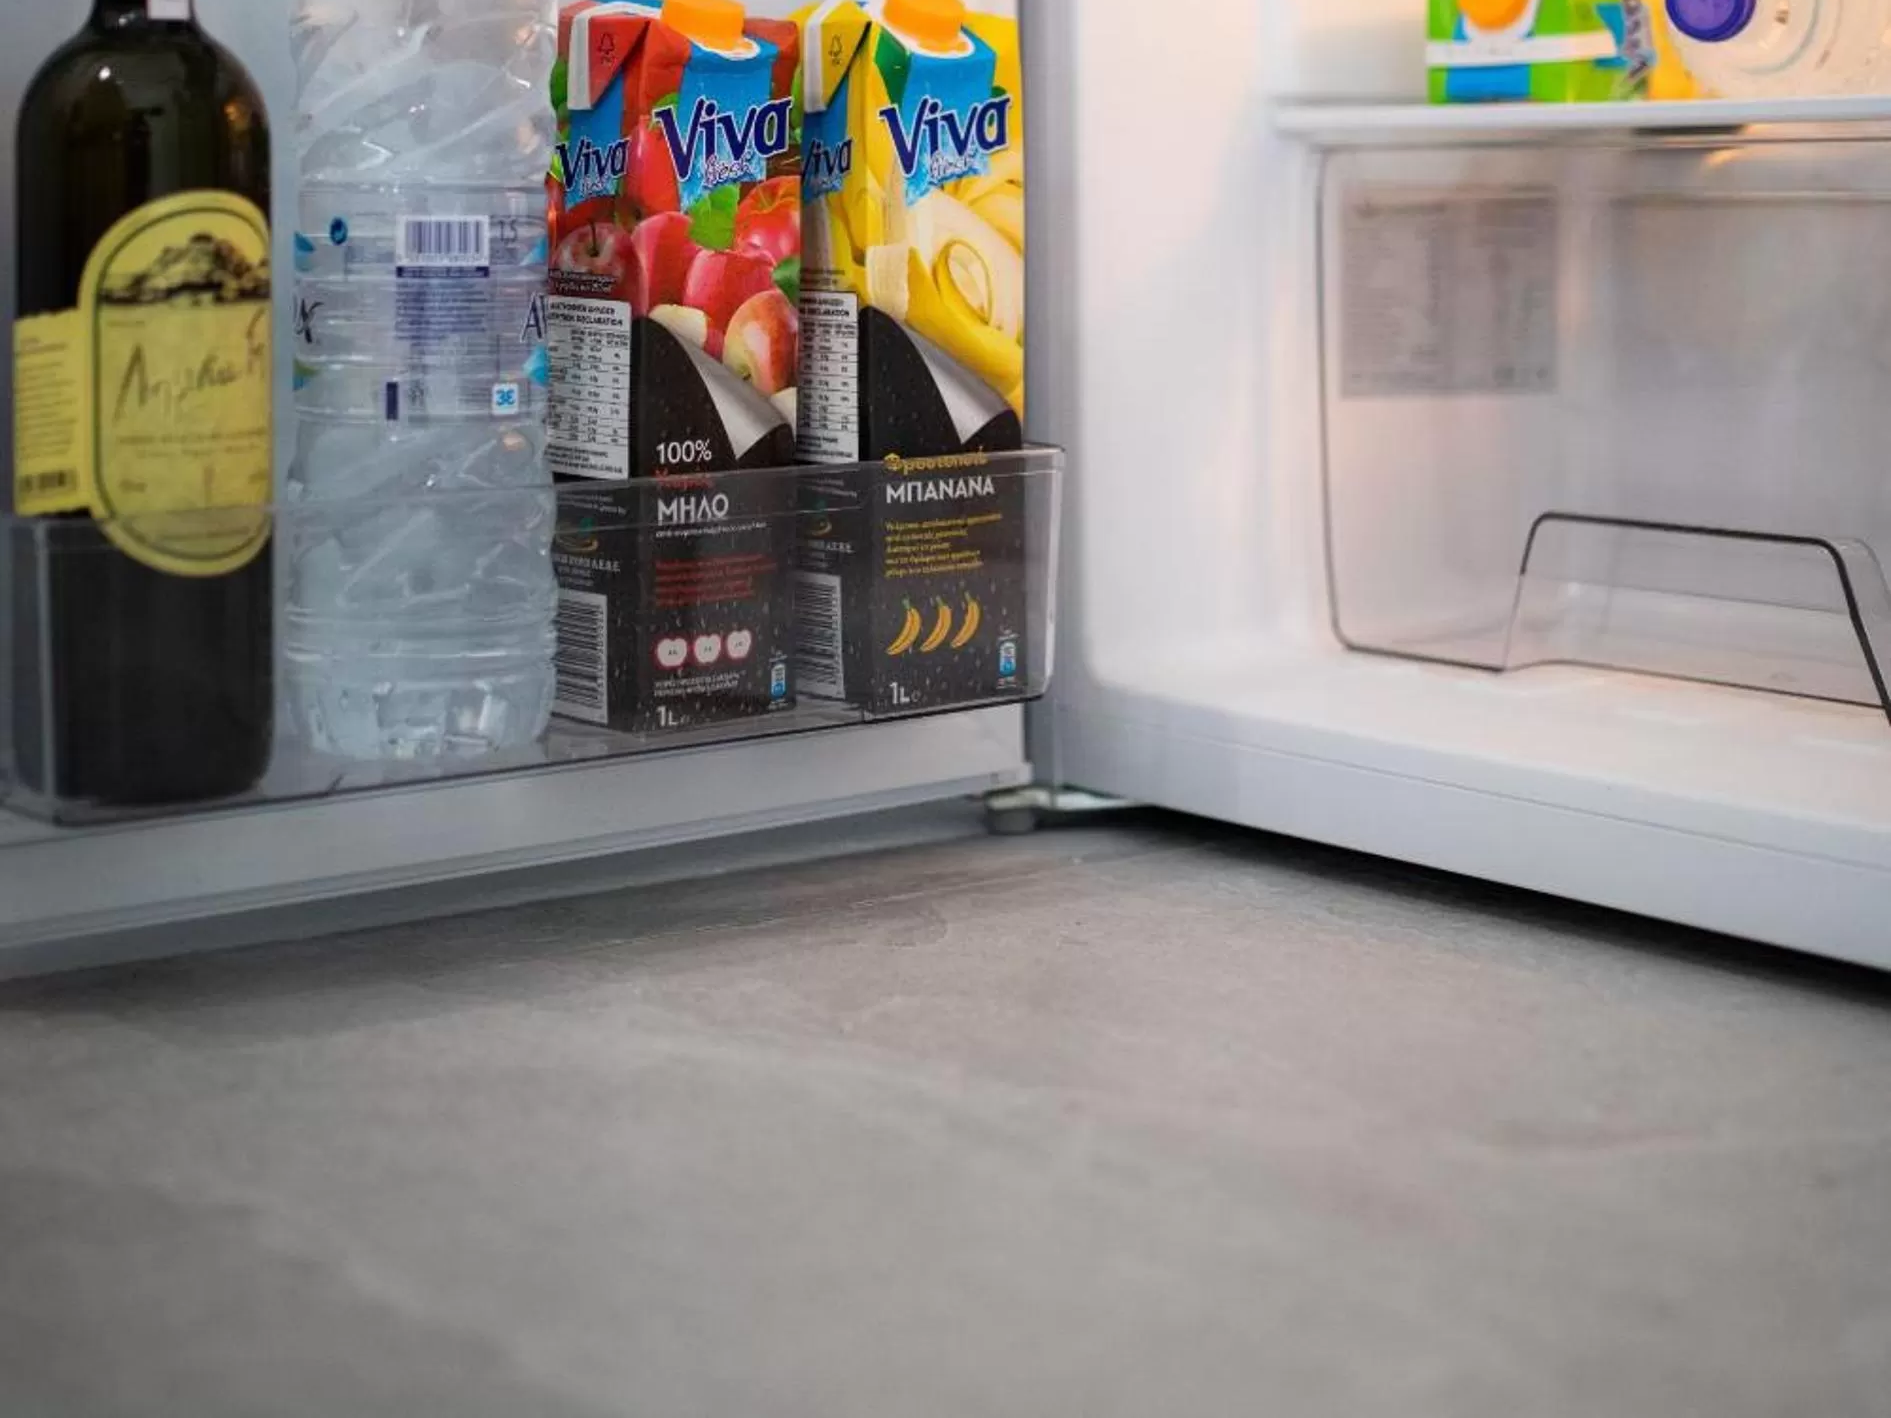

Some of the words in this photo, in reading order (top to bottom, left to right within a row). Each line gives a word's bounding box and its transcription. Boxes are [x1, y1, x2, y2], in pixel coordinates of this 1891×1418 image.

[654, 97, 791, 180] Viva
[880, 96, 1010, 176] Viva
[556, 136, 630, 188] Viva
[656, 438, 713, 464] 100%
[657, 493, 729, 526] ΜΗΛΟ
[886, 475, 996, 504] ΜΠΑΝΑΝΑ
